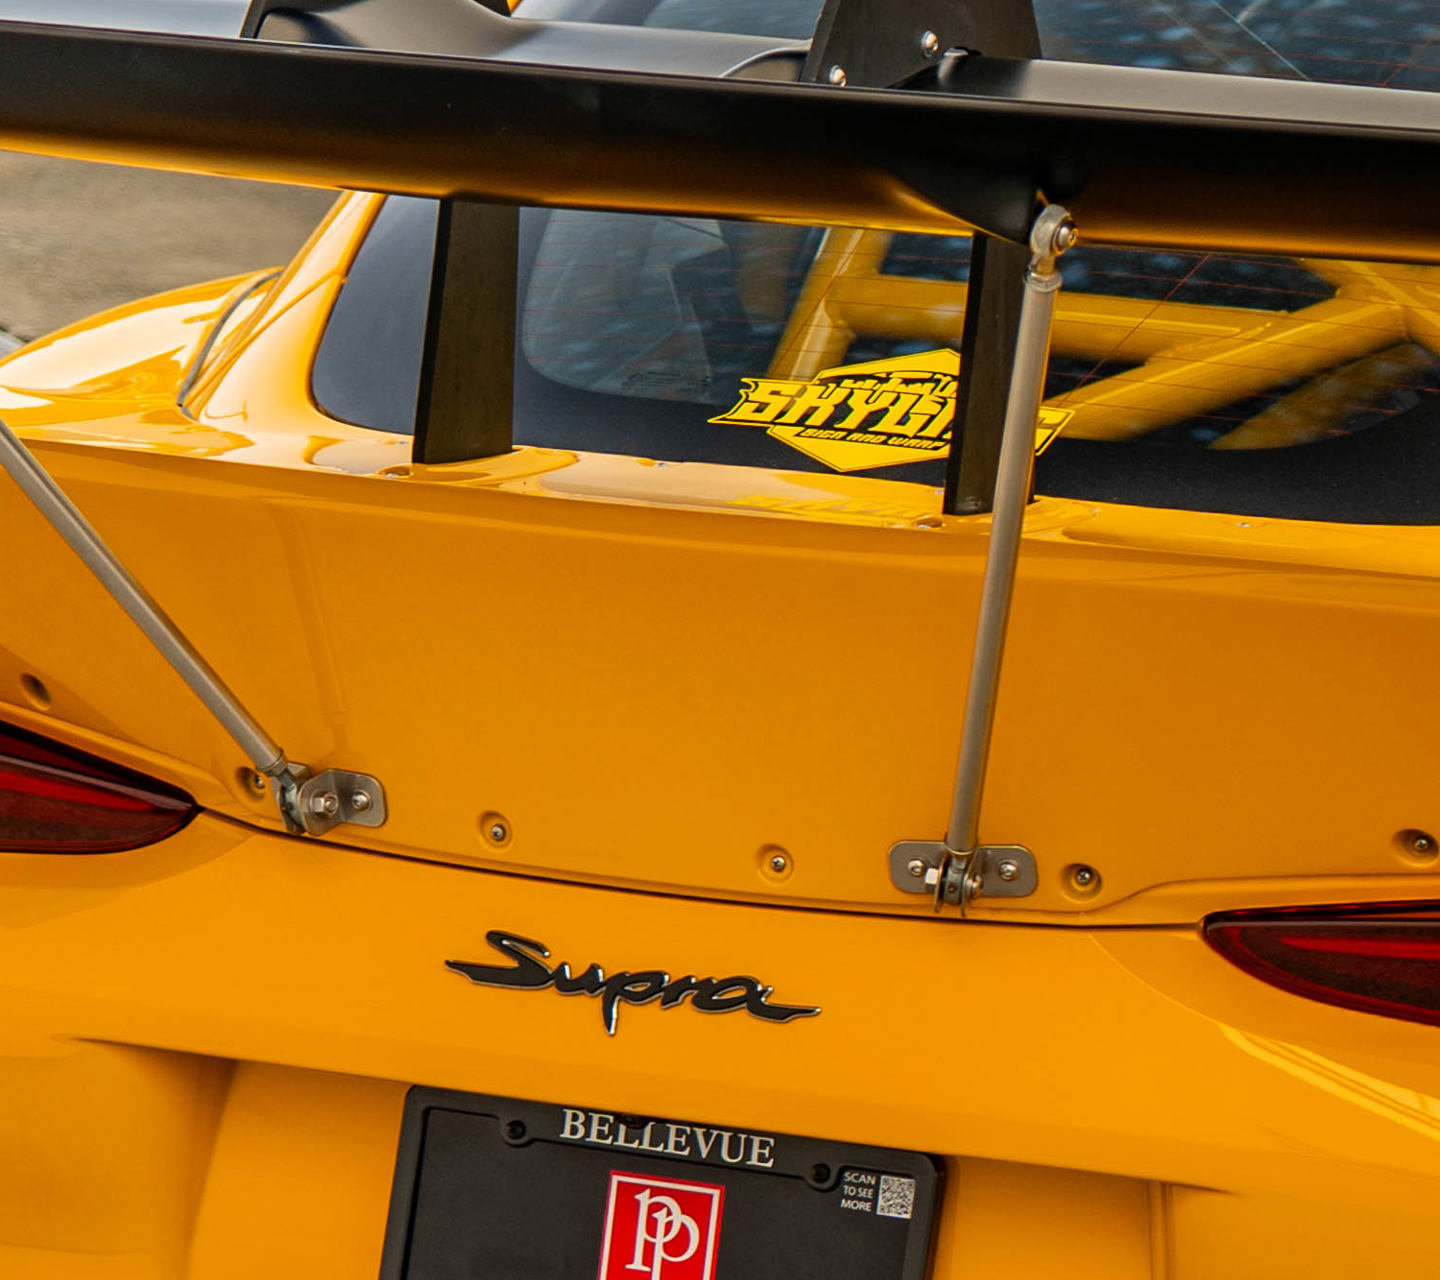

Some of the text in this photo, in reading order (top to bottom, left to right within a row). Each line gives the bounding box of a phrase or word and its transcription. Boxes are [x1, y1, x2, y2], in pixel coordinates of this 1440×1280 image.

[445, 929, 822, 1037] Supra
[560, 1108, 776, 1168] BELLEVUE
[843, 1171, 877, 1185] SCAN
[842, 1185, 874, 1199] TO SEE
[840, 1198, 873, 1212] MORE
